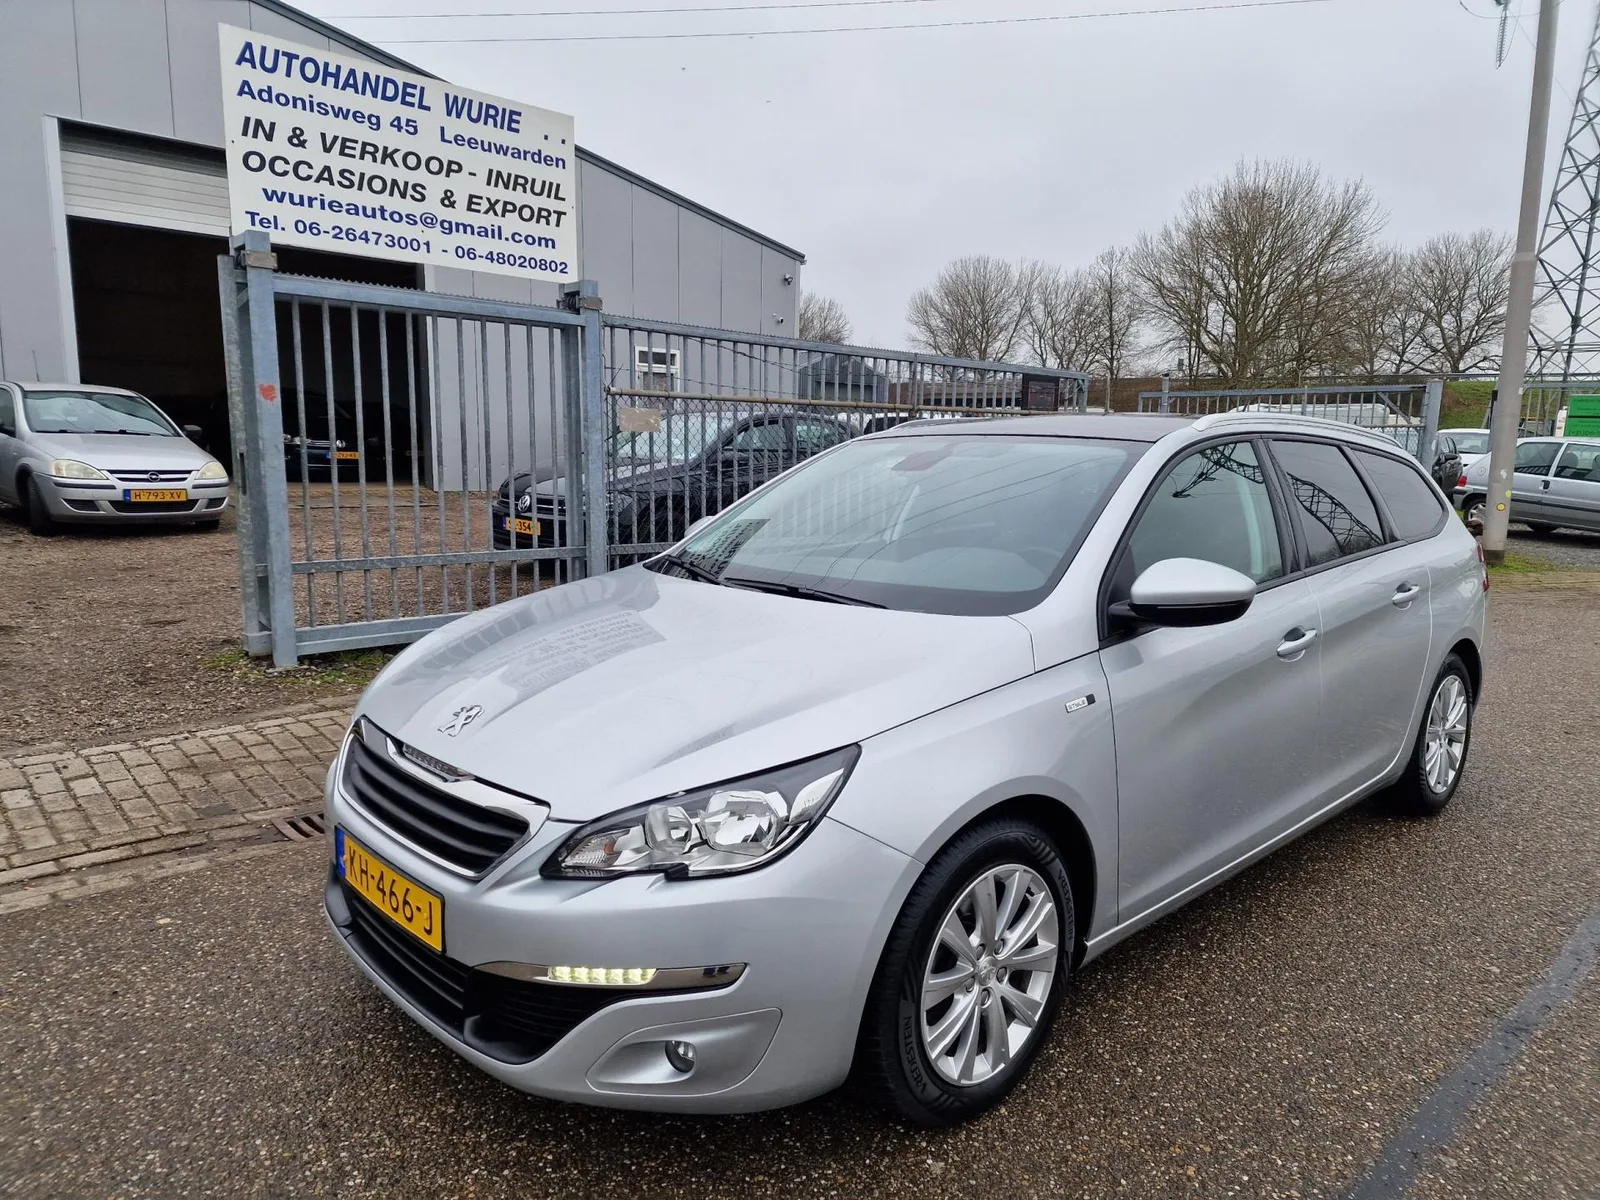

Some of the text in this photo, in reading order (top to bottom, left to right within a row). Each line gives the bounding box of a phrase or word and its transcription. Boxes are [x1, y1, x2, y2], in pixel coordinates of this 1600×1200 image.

[235, 41, 522, 133] AUTOHANDEL WURIE
[237, 80, 565, 169] Adonisweg 45 Leeuwarden
[242, 116, 276, 142] IN
[287, 127, 307, 149] &
[320, 132, 463, 178] VERKOOP
[486, 168, 565, 201] INRUIL
[242, 151, 567, 227] OCCASIONS & EXPORT
[245, 211, 286, 232] Tel.
[294, 220, 430, 253] 06-26473001
[455, 246, 568, 274] 06-48020802
[262, 188, 555, 249] wurieautos@gmail.com
[134, 491, 182, 500] H-793-XV
[348, 845, 433, 936] KH-466-J
